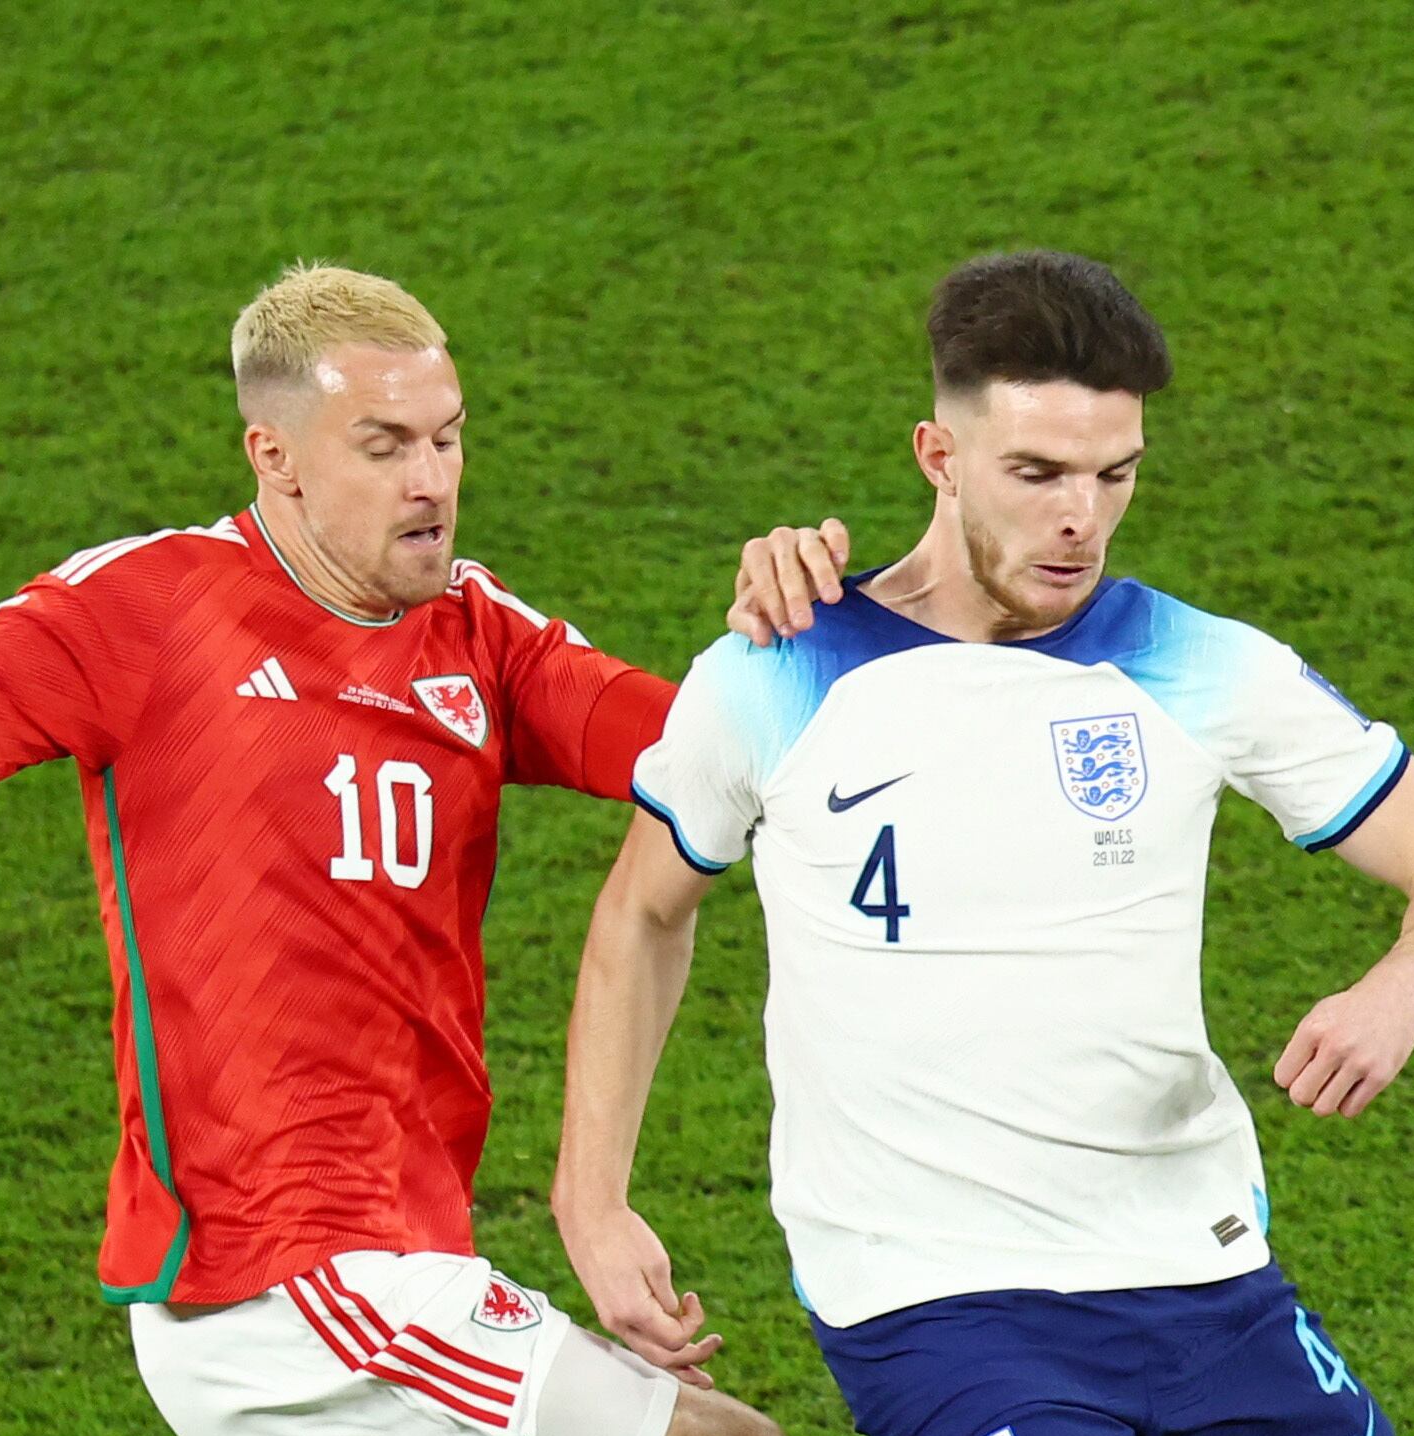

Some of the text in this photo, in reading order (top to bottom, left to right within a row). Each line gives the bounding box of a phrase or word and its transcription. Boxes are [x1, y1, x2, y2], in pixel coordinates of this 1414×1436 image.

[323, 753, 434, 889] 10
[1093, 850, 1135, 866] 29.11.22
[1094, 829, 1133, 845] WALES
[850, 824, 911, 943] 4
[1295, 1305, 1359, 1396] 4
